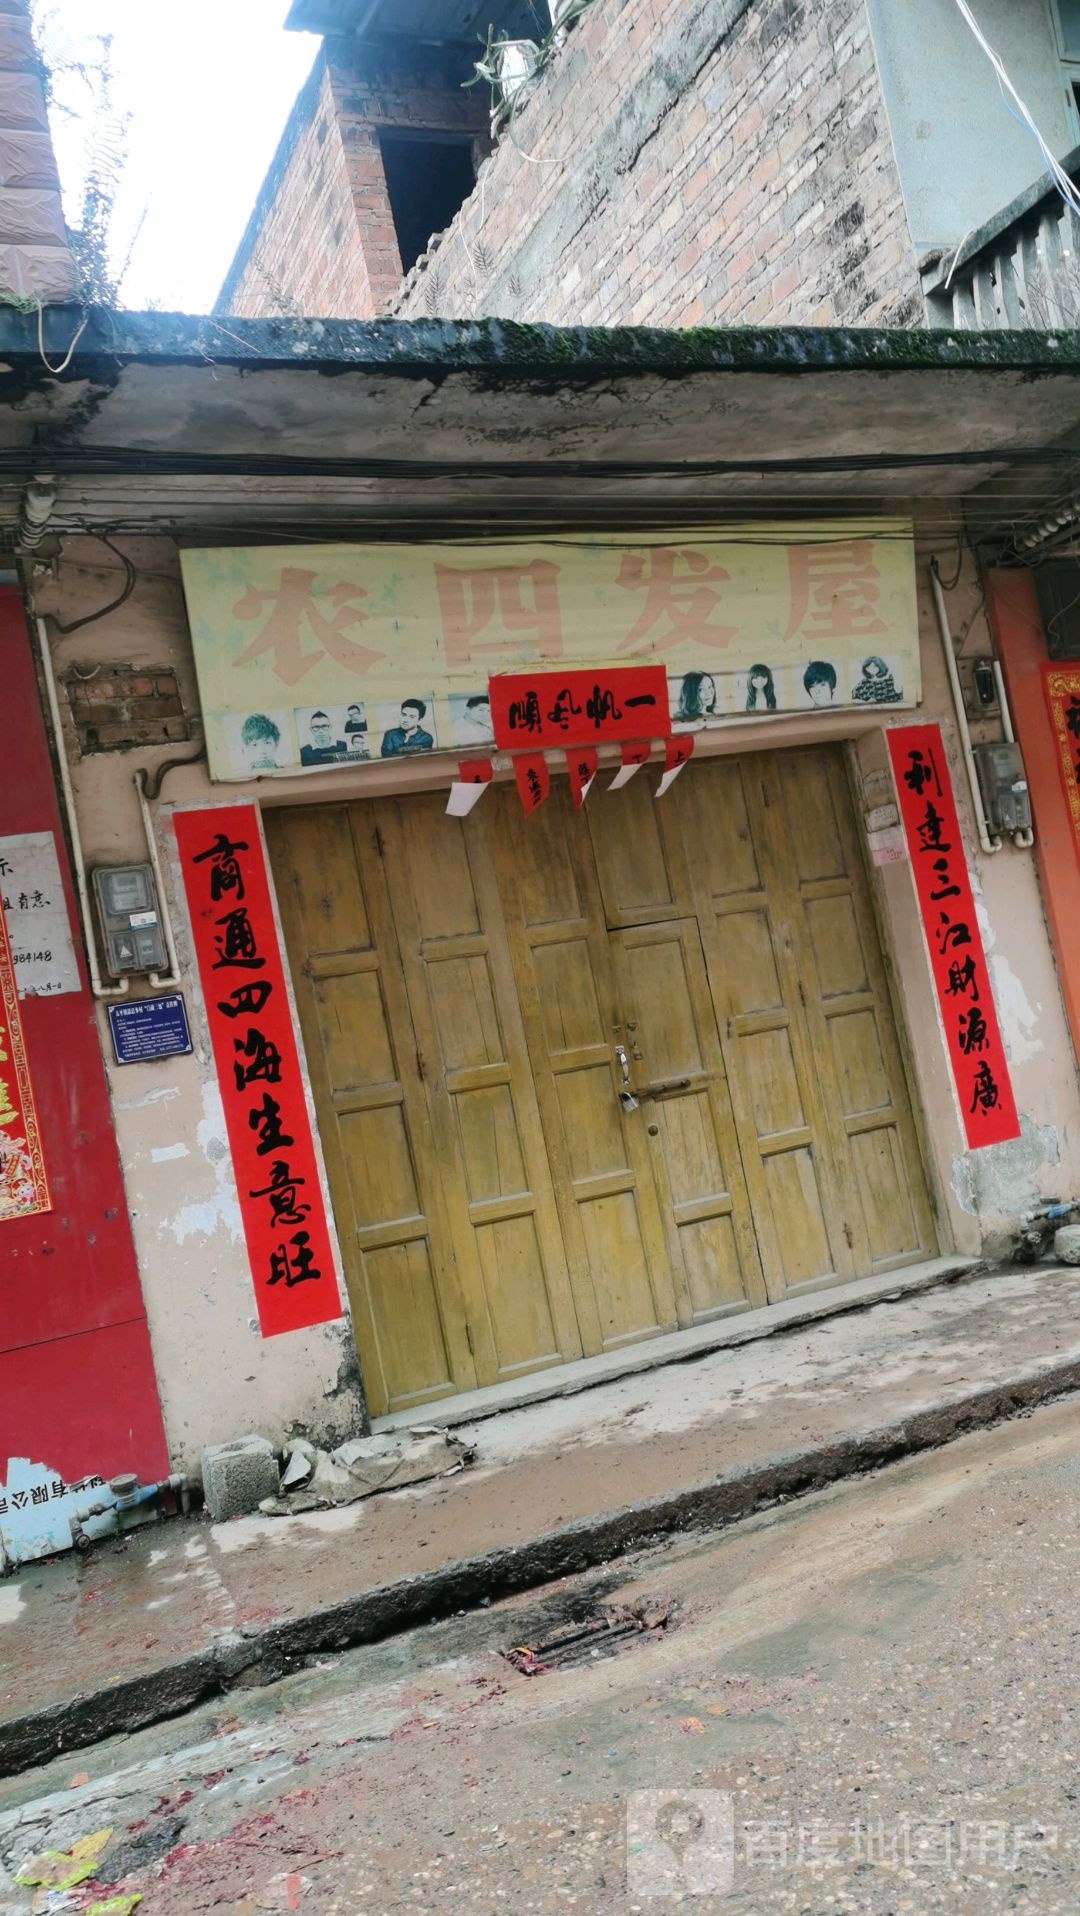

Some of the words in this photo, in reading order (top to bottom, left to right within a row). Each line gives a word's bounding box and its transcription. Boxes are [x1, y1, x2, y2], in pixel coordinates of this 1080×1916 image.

[230, 541, 889, 686] 农四发屋
[192, 834, 323, 1288] 商通四海生意旺
